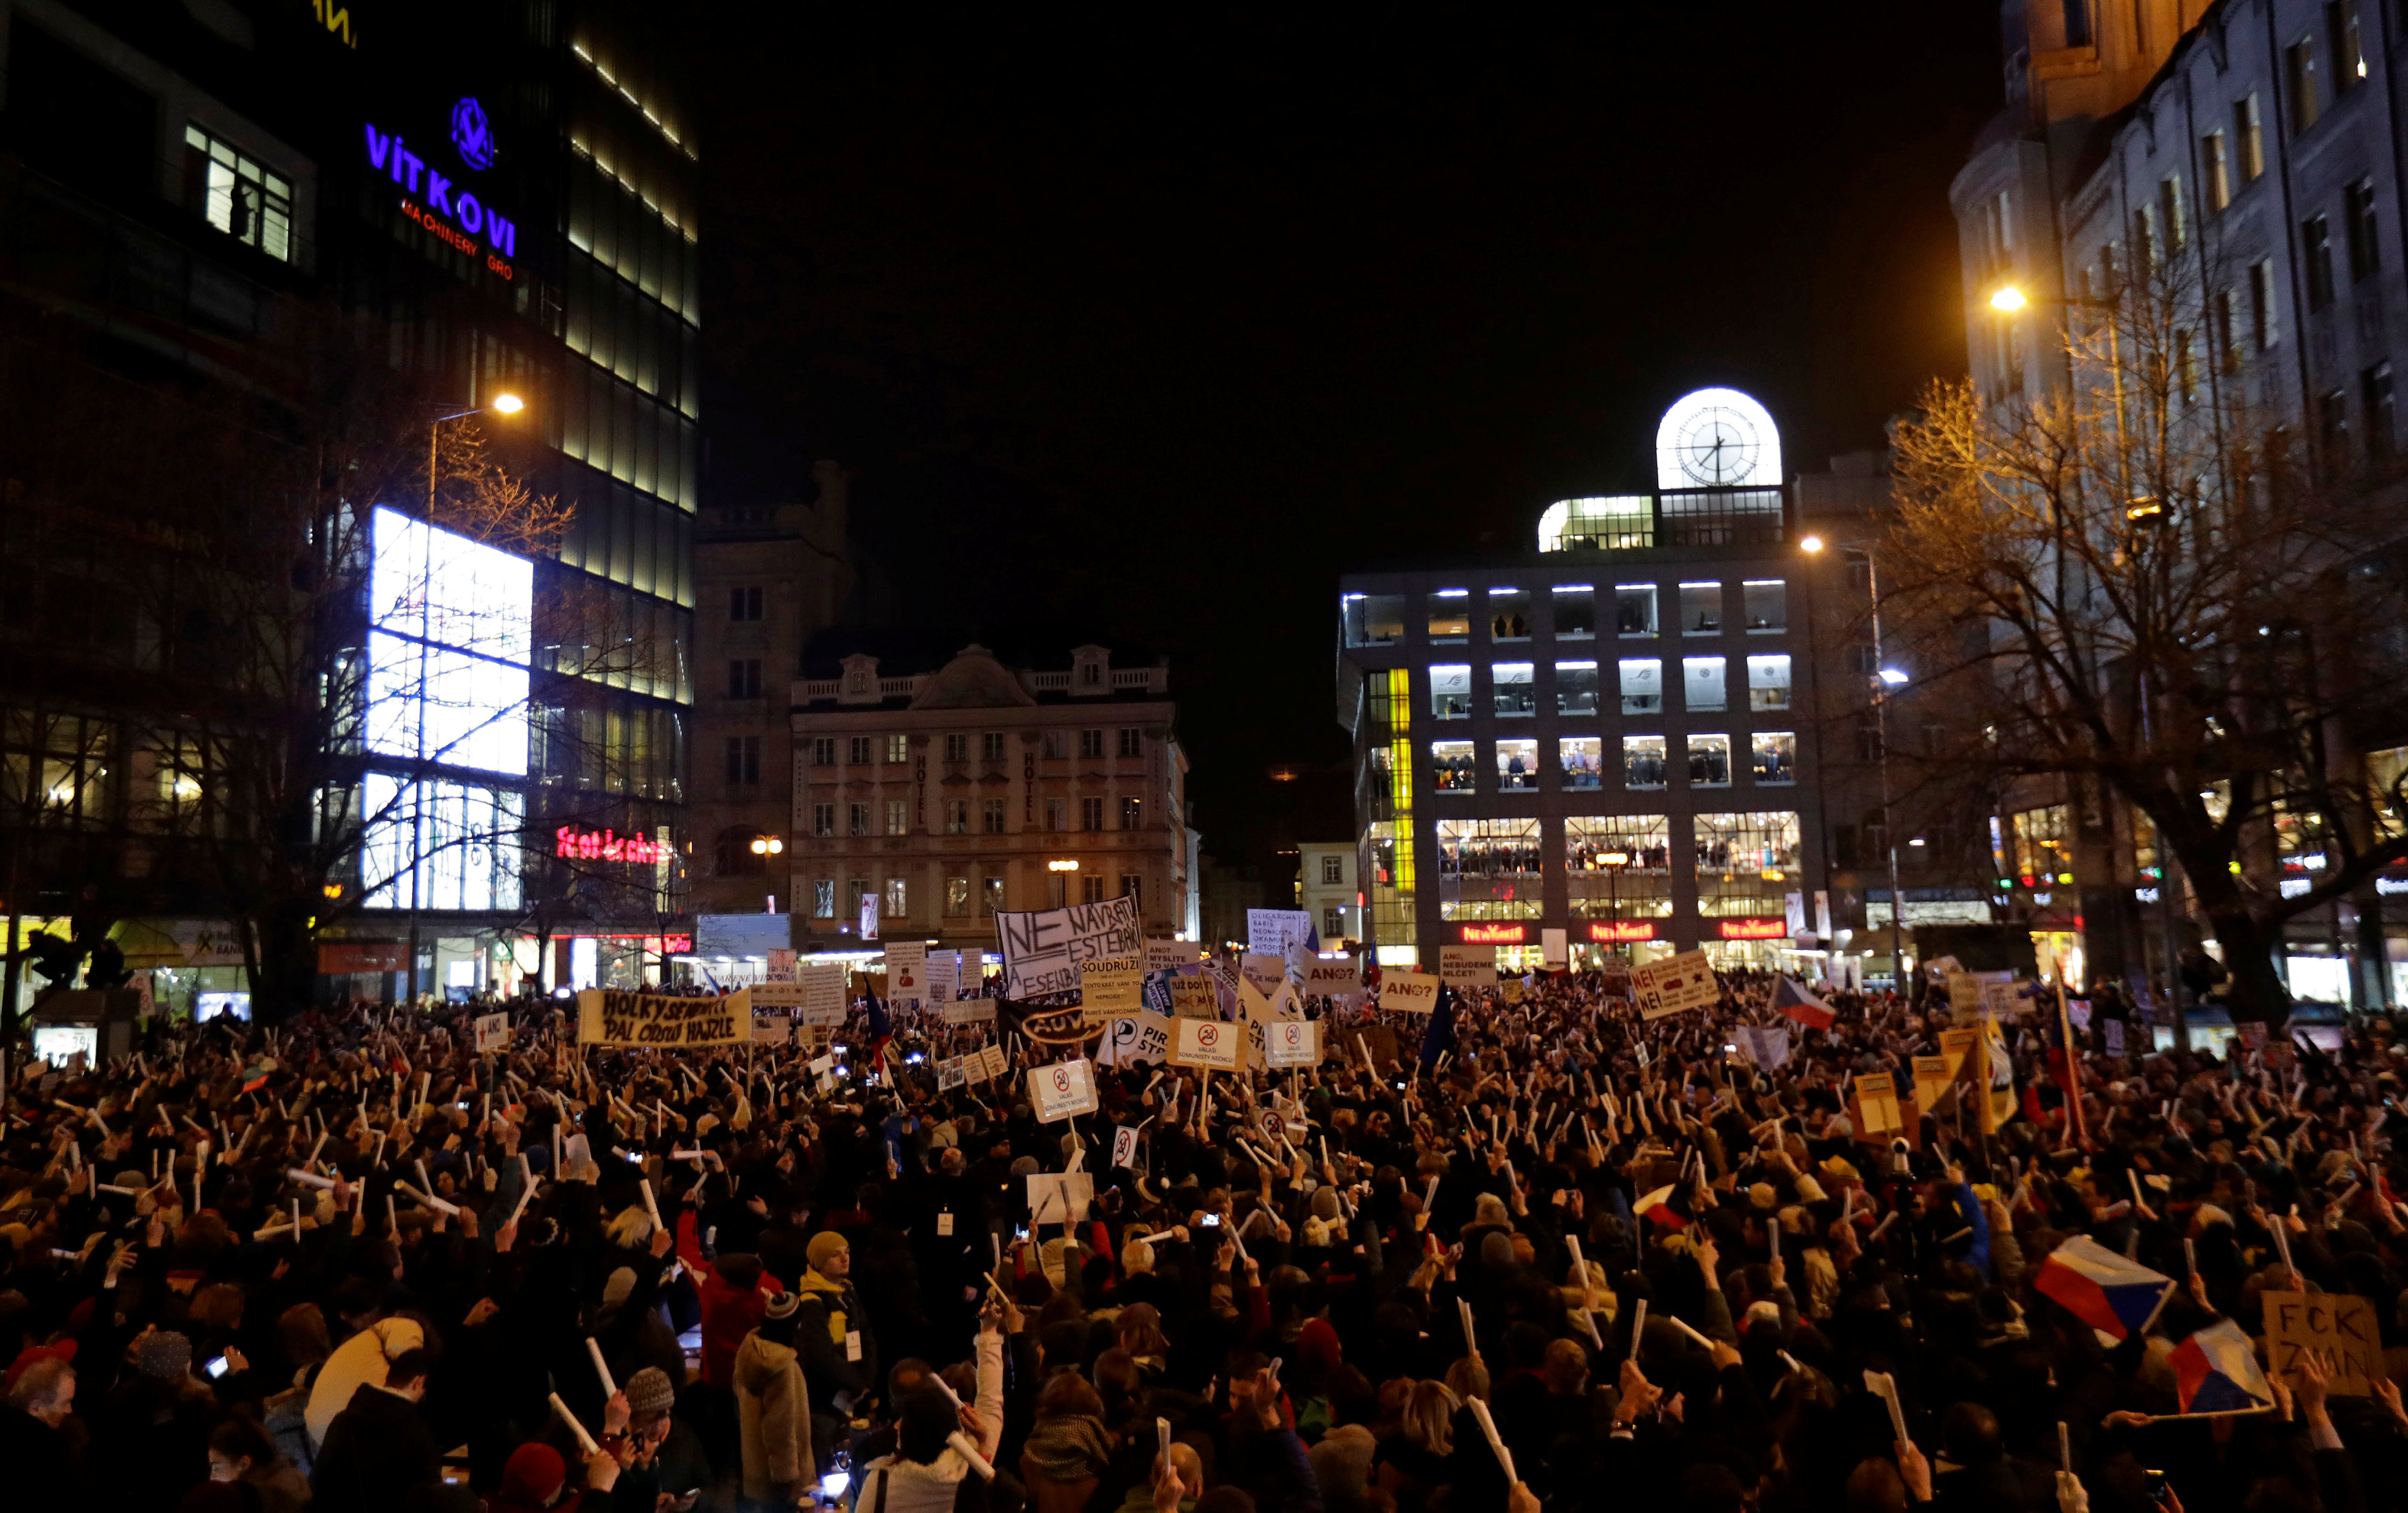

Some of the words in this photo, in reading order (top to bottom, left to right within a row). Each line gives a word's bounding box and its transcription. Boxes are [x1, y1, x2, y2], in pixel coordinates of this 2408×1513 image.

[916, 755, 926, 824] HOTEL
[1024, 753, 1034, 822] HOTEL
[1004, 909, 1066, 958] NE
[1310, 968, 1355, 980] ANO?
[1386, 983, 1432, 997] ANO?
[1178, 1051, 1212, 1060] KOMUNISTY
[2279, 1304, 2371, 1344] FCK
